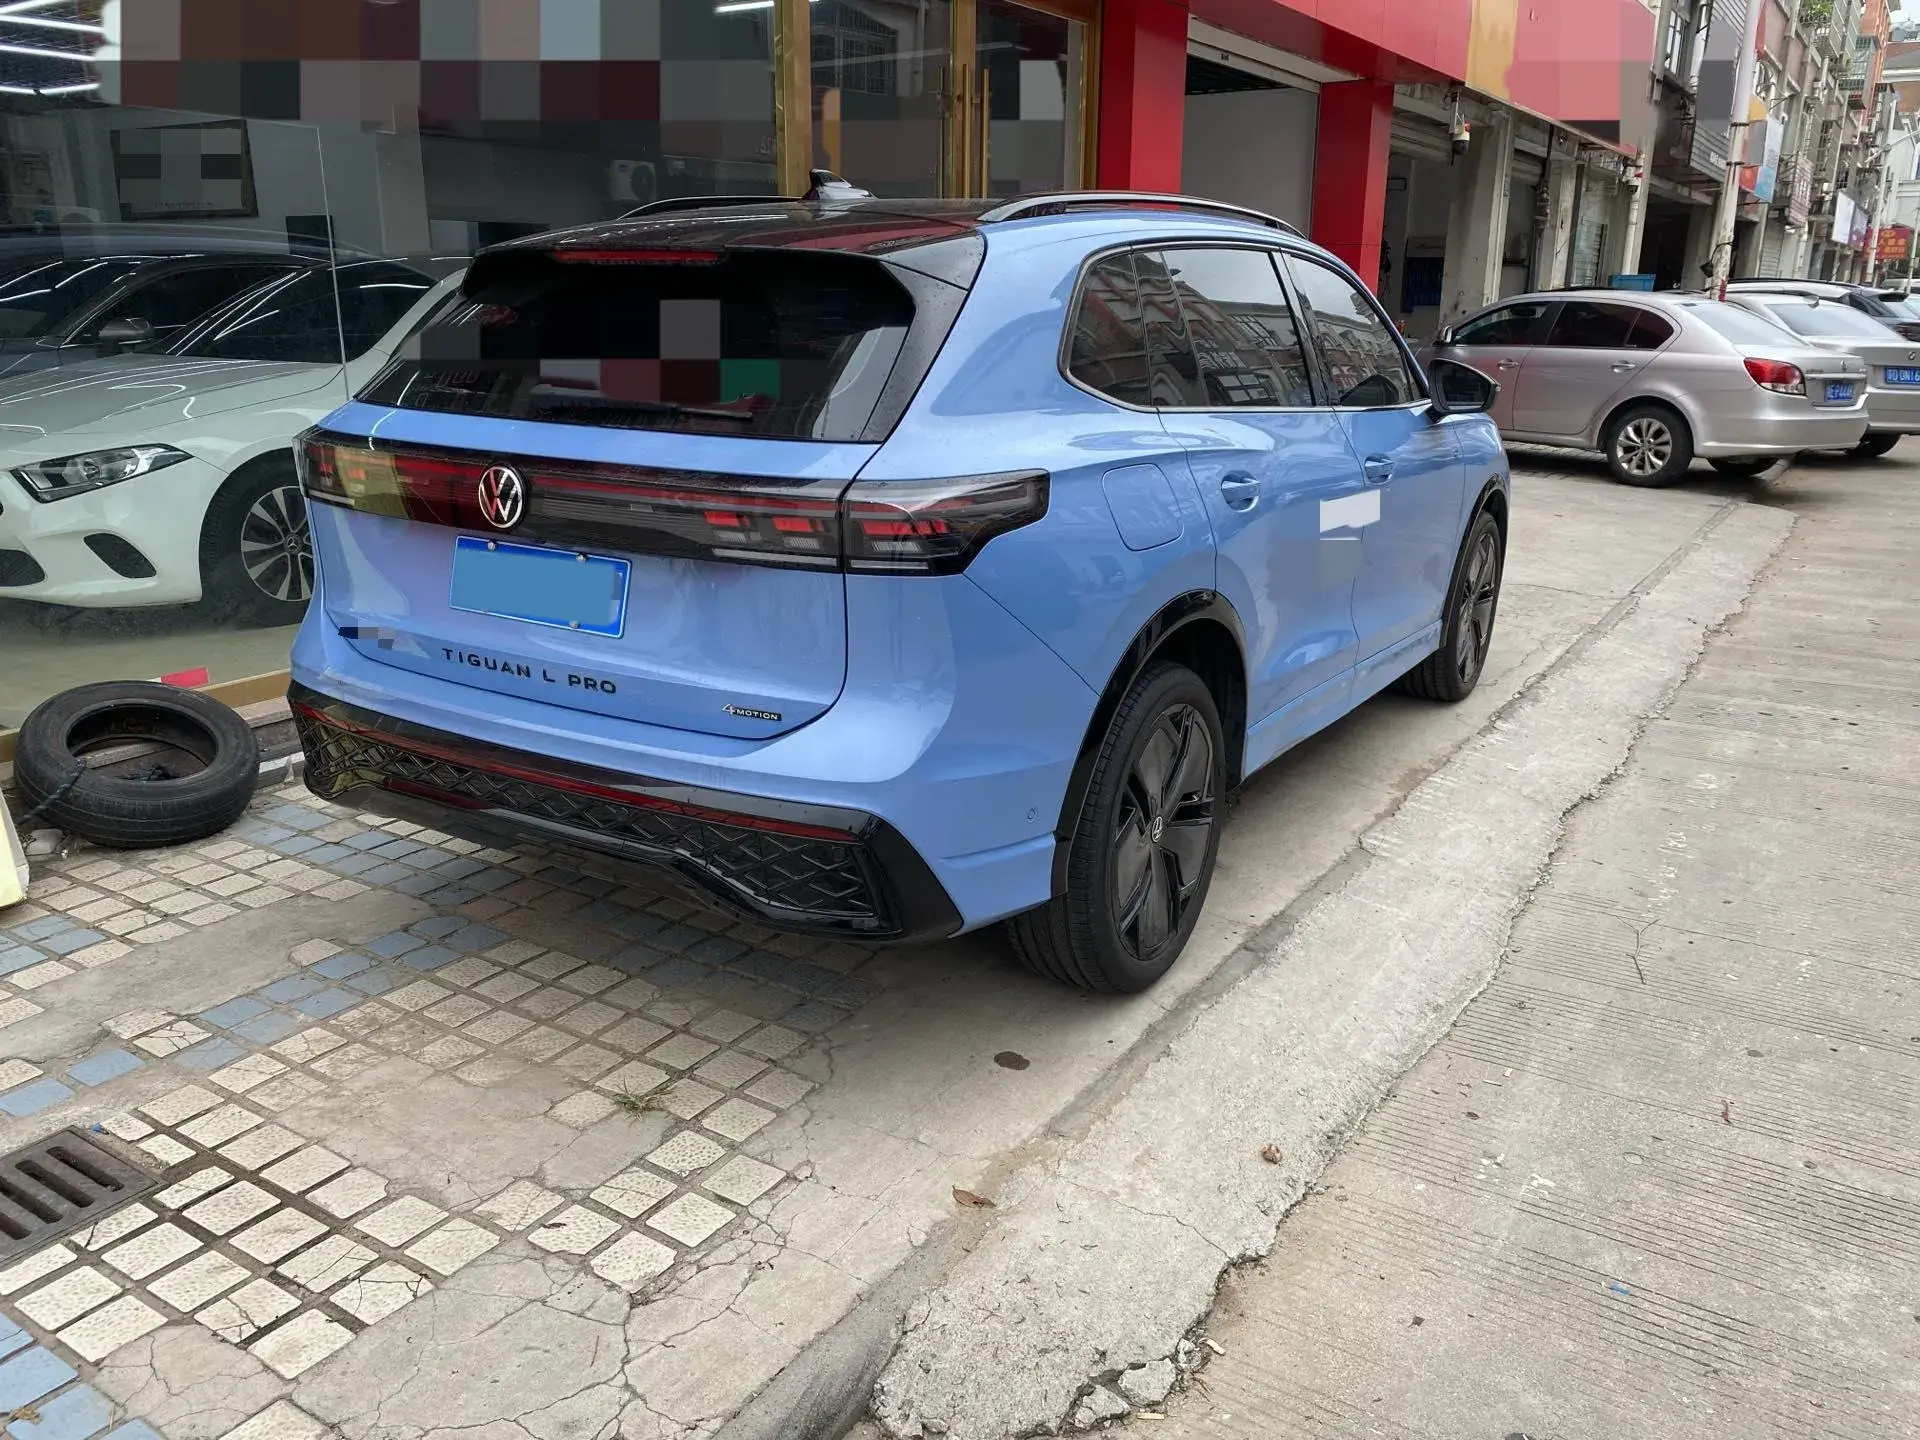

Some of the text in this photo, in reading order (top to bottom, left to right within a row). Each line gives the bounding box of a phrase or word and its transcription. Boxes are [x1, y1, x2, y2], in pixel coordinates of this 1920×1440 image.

[442, 648, 617, 694] TIGUAN L PRO
[721, 703, 778, 720] 4MOTION
